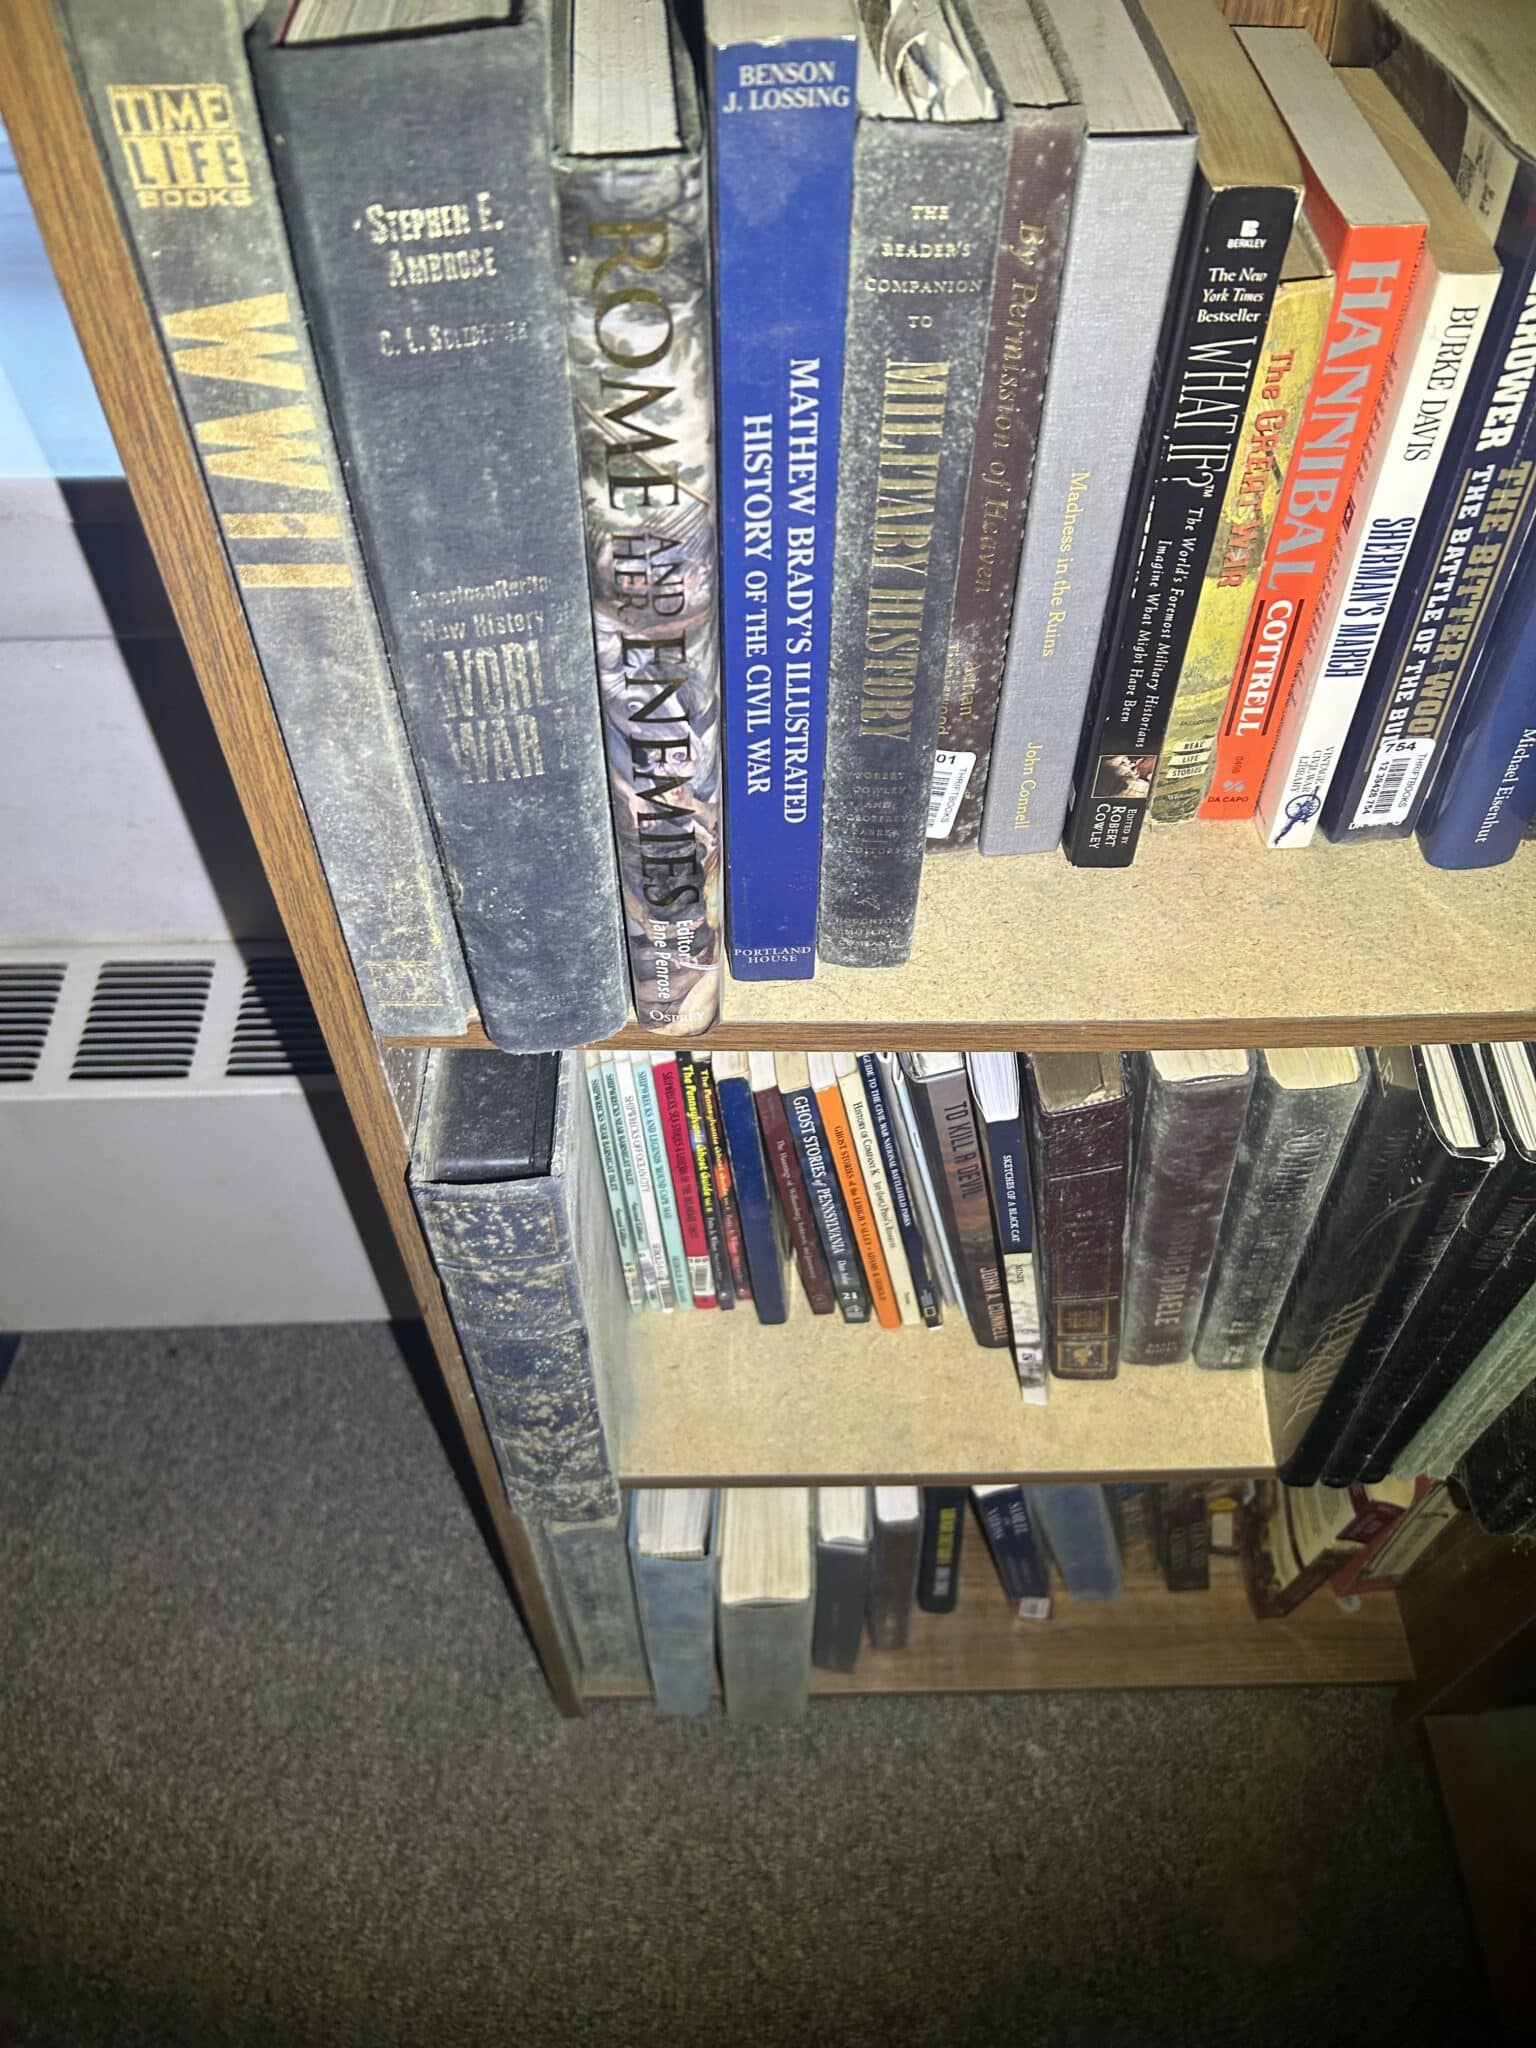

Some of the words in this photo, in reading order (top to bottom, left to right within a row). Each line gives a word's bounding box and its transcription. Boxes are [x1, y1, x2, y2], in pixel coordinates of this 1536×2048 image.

[739, 61, 836, 88] BENSON
[110, 86, 232, 133] TIME
[722, 91, 744, 114] J.
[750, 86, 850, 111] LOSSING
[127, 138, 246, 185] LIFE
[136, 187, 254, 208] BOOKS
[476, 191, 504, 232] E.
[911, 205, 949, 220] THE
[881, 240, 971, 258] READER'S
[1007, 219, 1047, 267] By
[1227, 238, 1267, 249] BERKLEY
[389, 246, 498, 288] AMBROSE
[863, 277, 982, 294] COMPANION
[1208, 267, 1237, 283] The
[1239, 266, 1268, 283] New
[1202, 288, 1229, 303] York
[1233, 287, 1264, 302] Times
[907, 315, 933, 329] TO
[1197, 308, 1261, 323] Bestseller
[588, 218, 680, 511] ROME
[993, 277, 1039, 449] Permission
[1426, 305, 1481, 391] BURKE
[1174, 335, 1258, 434] WHAT
[1261, 348, 1297, 402] The
[787, 357, 821, 517] MATHEW
[1268, 258, 1402, 592] HANNIBAL
[1403, 400, 1448, 463] DAVIS
[871, 357, 950, 577] MILITARY
[981, 460, 1012, 493] of
[743, 413, 773, 561] HISTORY
[1457, 463, 1496, 520] THE
[1478, 460, 1534, 533] THE
[1057, 470, 1089, 554] Madness
[1183, 505, 1202, 531] The
[975, 495, 1009, 594] Heaven
[1147, 538, 1170, 587] Imagine
[1172, 536, 1195, 583] World's
[612, 533, 648, 619] HER
[645, 532, 686, 618] AND
[1055, 556, 1073, 576] in
[1343, 517, 1416, 619] SHERMAN'S
[1421, 526, 1473, 623] BATTLE
[744, 570, 768, 603] OF
[785, 526, 816, 656] BRADY'S
[1050, 579, 1070, 607] the
[1431, 538, 1496, 664] BITTER
[472, 610, 546, 640] History
[1141, 591, 1158, 625] What
[1160, 587, 1183, 638] Foremost
[745, 609, 768, 658] THE
[1042, 609, 1065, 658] Ruins
[1130, 629, 1150, 663] Might
[1323, 624, 1381, 679] MARCH
[1412, 627, 1437, 655] OF
[858, 587, 927, 742] HISTORY
[1126, 667, 1142, 695] Have
[1145, 642, 1171, 691] Military
[1235, 599, 1293, 737] COTTRELL
[1394, 659, 1428, 704] THE
[745, 664, 773, 734] CIVIL
[959, 659, 982, 717] Adrian
[1120, 699, 1135, 722] Been
[1134, 694, 1158, 748] Historians
[783, 662, 811, 824] ILLUSTRATED
[936, 754, 956, 765] 01
[1021, 741, 1043, 777] John
[1182, 755, 1199, 763] LIFE
[1183, 741, 1204, 750] REAL
[1386, 742, 1416, 753] 754
[1501, 728, 1536, 783] Michael
[621, 631, 700, 908] ENEMIES
[745, 738, 771, 796] WAR
[1172, 766, 1202, 777] STORIES
[1301, 772, 1314, 793] WAR
[1398, 753, 1428, 809] THRIFTBOOKS
[940, 768, 968, 823] THRIFTBOOKS
[1011, 778, 1038, 831] Connell
[1474, 782, 1517, 845] Eisenhut
[1087, 802, 1111, 850] COWLEY
[1104, 805, 1127, 848] ROBERT
[648, 918, 669, 949] Jane
[675, 919, 695, 961] Editor
[734, 946, 812, 956] PORTLAND
[654, 951, 672, 999] Penrose
[748, 954, 798, 963] HOUSE
[681, 1064, 694, 1083] The
[700, 1069, 710, 1086] The
[861, 1055, 873, 1076] GUIDE
[867, 1078, 876, 1087] TO
[591, 1079, 605, 1122] SHIPWRECKS
[605, 1073, 620, 1114] SHIPWRECKS
[637, 1072, 653, 1115] SHIPWRECKS
[646, 1117, 656, 1133] AND
[870, 1089, 880, 1102] THE
[873, 1103, 884, 1120] CIVIL
[943, 1102, 968, 1120] TO
[682, 1084, 704, 1143] Pennsylvania
[701, 1088, 720, 1144] Pennsylvania
[792, 1096, 816, 1135] GHOST
[878, 1122, 888, 1137] WAR
[622, 1095, 640, 1139] SHIPWRECKS
[639, 1178, 648, 1192] CITY
[833, 1126, 846, 1149] GHOST
[853, 1102, 867, 1129] HISTORY
[862, 1139, 877, 1169] COMPANY
[882, 1137, 896, 1167] NATIONAL
[947, 1123, 974, 1150] KILL
[694, 1144, 708, 1170] Ghost
[713, 1145, 725, 1168] Ghost
[802, 1135, 827, 1178] STORIES
[839, 1151, 854, 1178] STORIES
[954, 1152, 976, 1162] A
[1002, 1154, 1015, 1188] SKETCHES
[699, 1171, 713, 1196] Guide
[718, 1171, 730, 1196] Guide
[811, 1178, 823, 1188] of
[889, 1169, 905, 1206] BATTLEFIELD
[956, 1164, 983, 1198] DEVIL
[1007, 1190, 1015, 1199] OF
[816, 1187, 845, 1253] PENNSYLVANIA
[899, 1207, 910, 1226] PARKS
[1008, 1208, 1019, 1228] BLACK
[1010, 1230, 1020, 1242] CAT
[979, 1265, 1000, 1291] JOHN
[988, 1302, 1008, 1339] CONNELL
